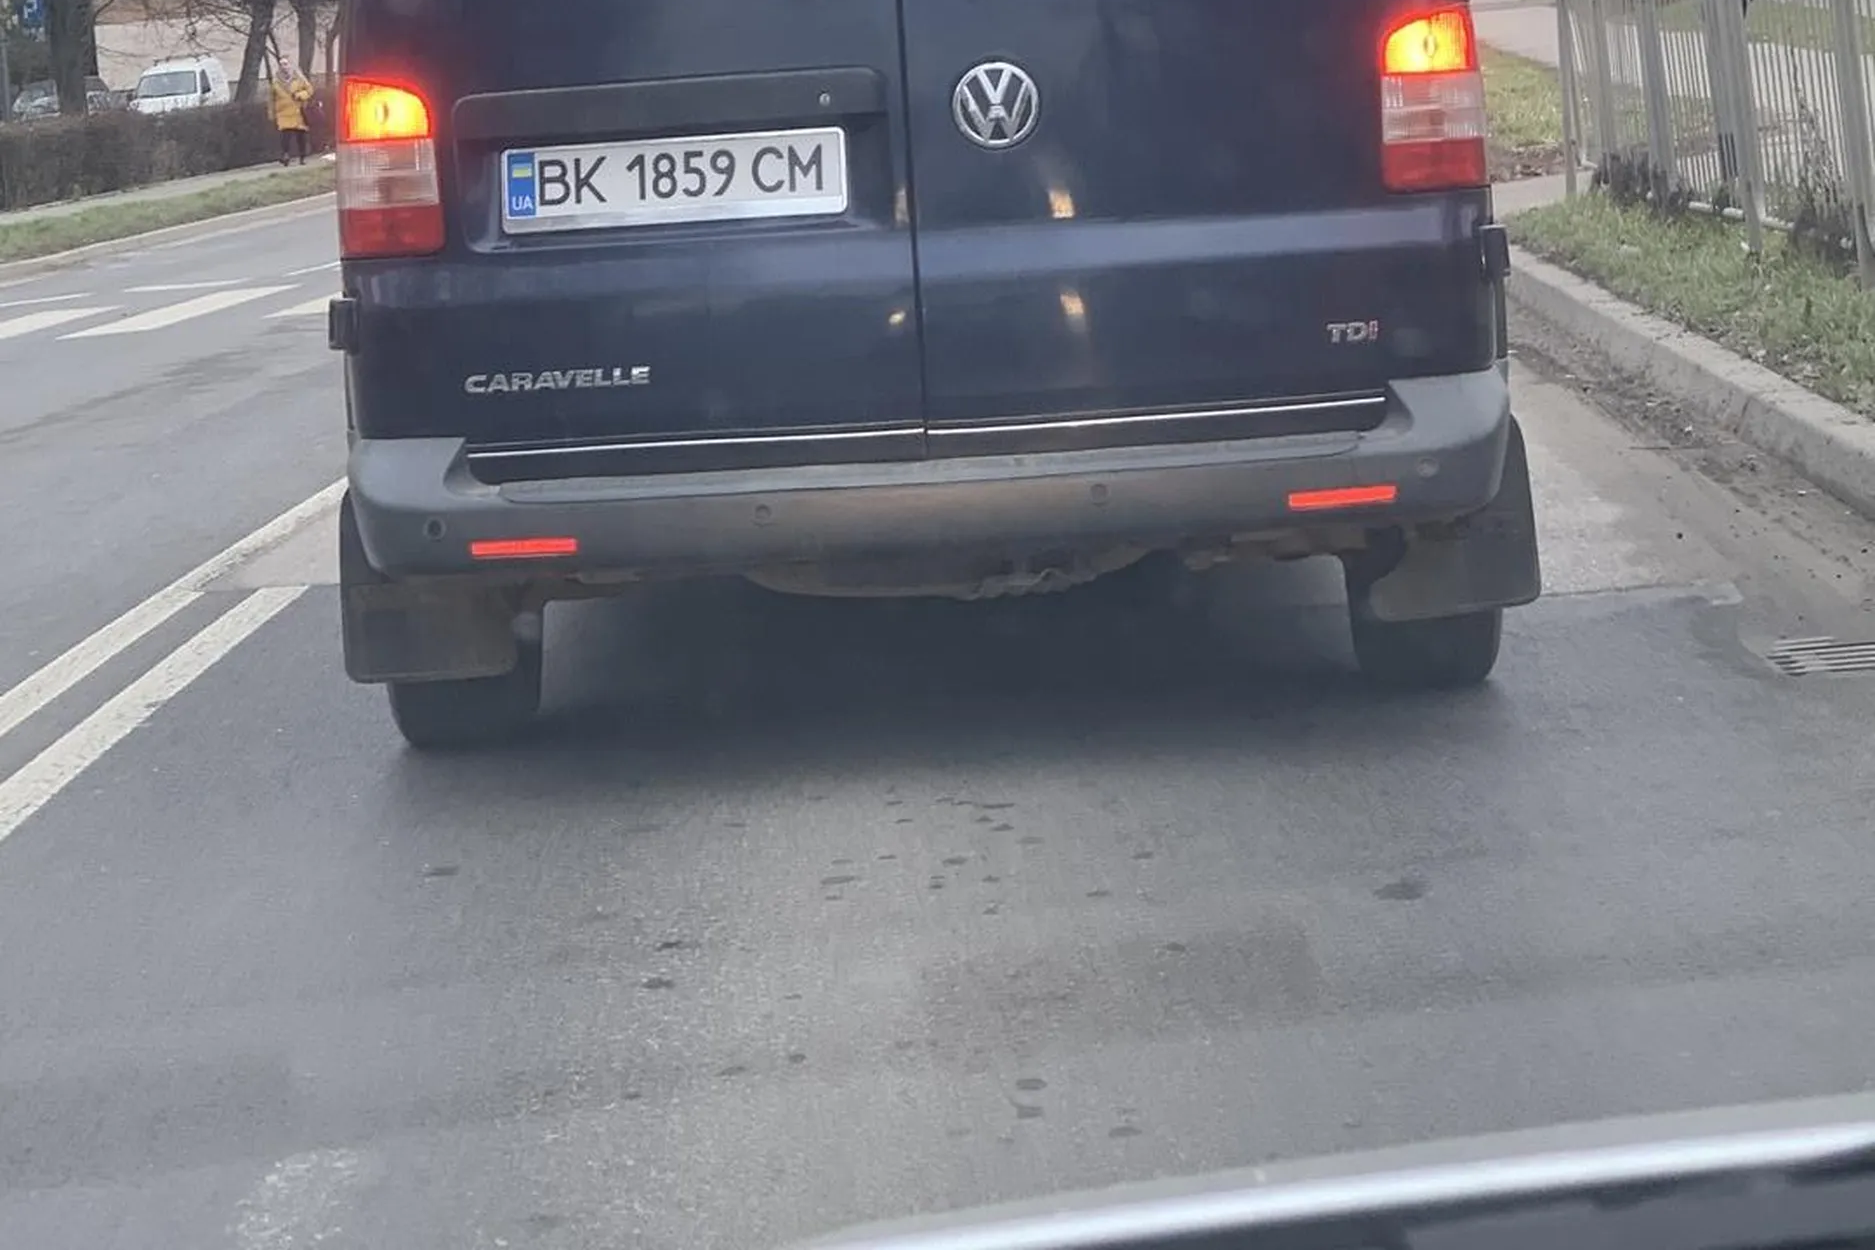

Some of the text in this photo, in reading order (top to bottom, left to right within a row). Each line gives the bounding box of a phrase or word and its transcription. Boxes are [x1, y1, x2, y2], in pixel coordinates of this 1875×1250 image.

[538, 143, 823, 206] BK 1859 CM
[512, 197, 533, 211] UA
[1326, 319, 1379, 343] TDI
[464, 365, 651, 393] CARAVELLE
